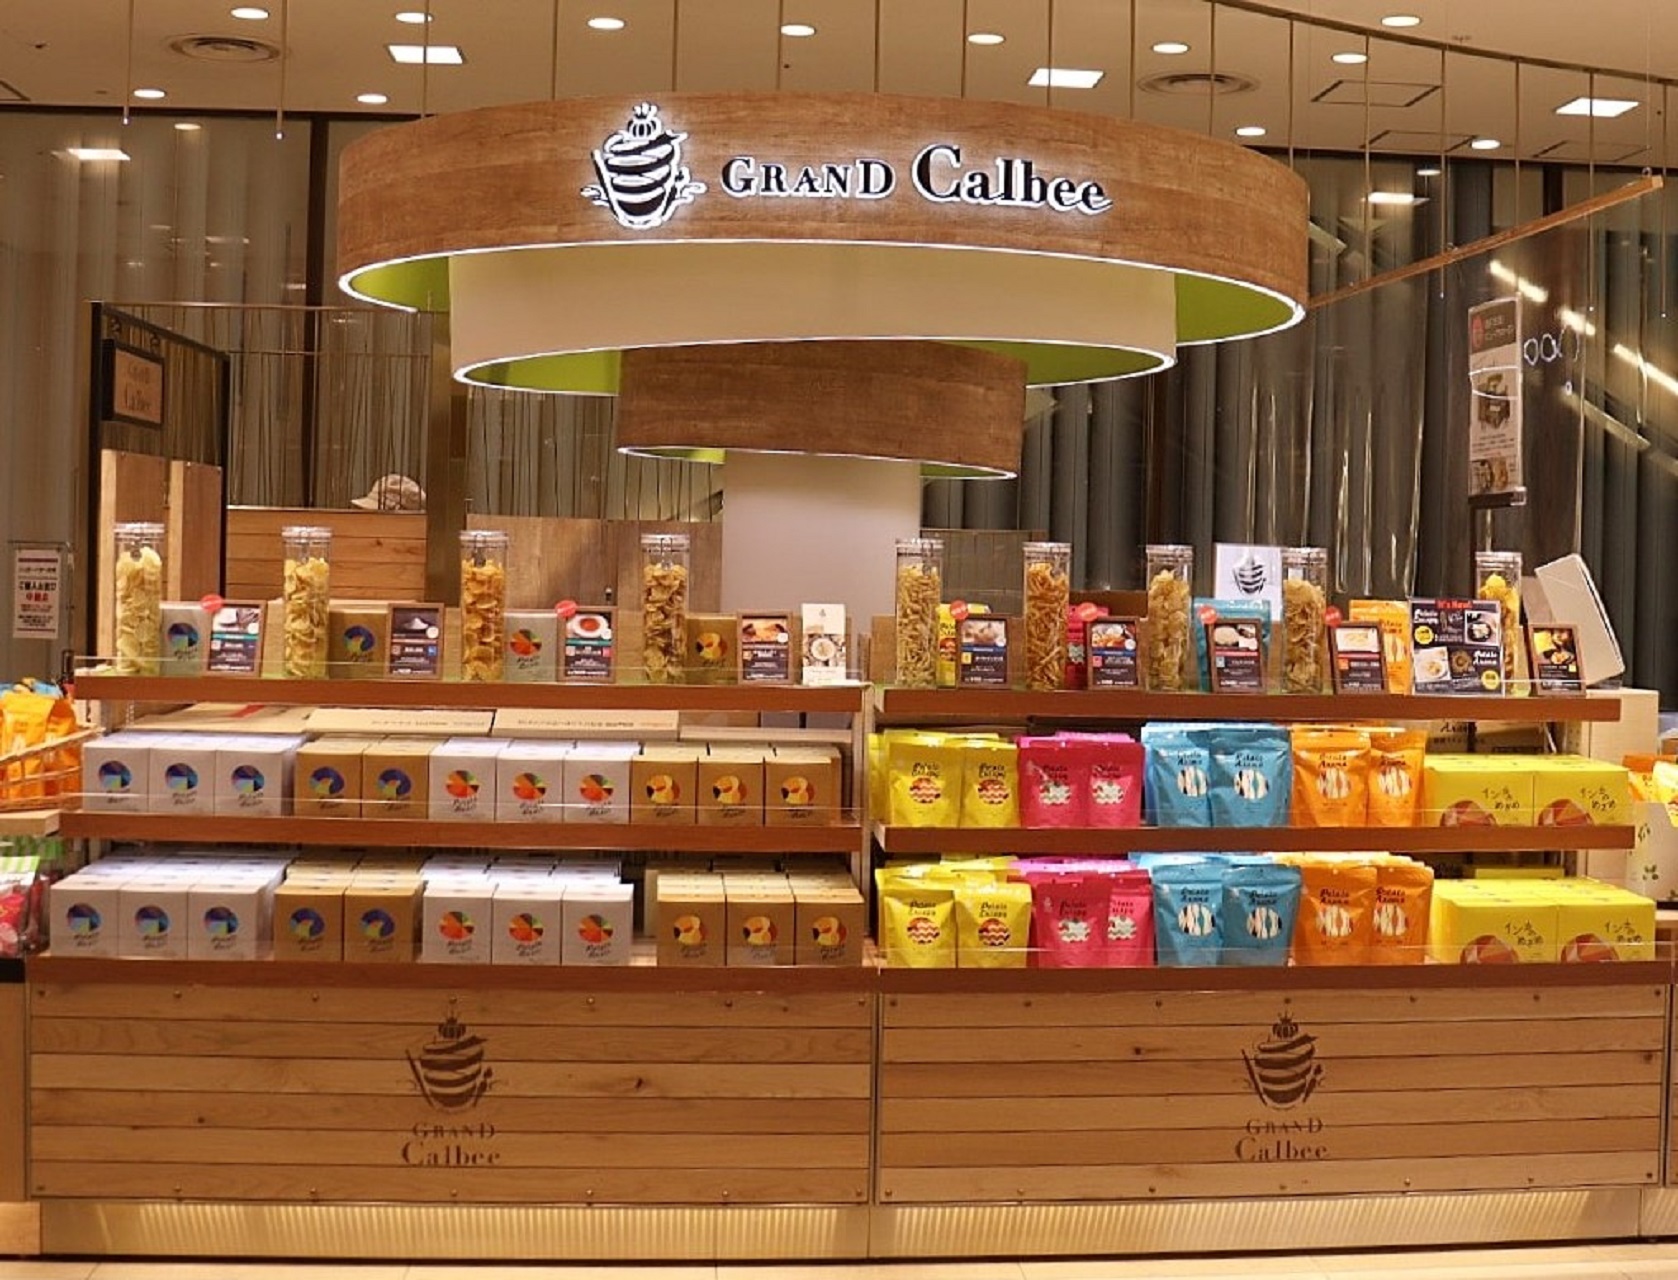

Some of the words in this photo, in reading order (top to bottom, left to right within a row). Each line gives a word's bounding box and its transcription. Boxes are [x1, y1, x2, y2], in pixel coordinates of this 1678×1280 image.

[721, 157, 896, 198] GRAND
[912, 143, 1113, 214] Calbee
[402, 1140, 500, 1166] Calbee
[1235, 1137, 1328, 1162] Calbee
